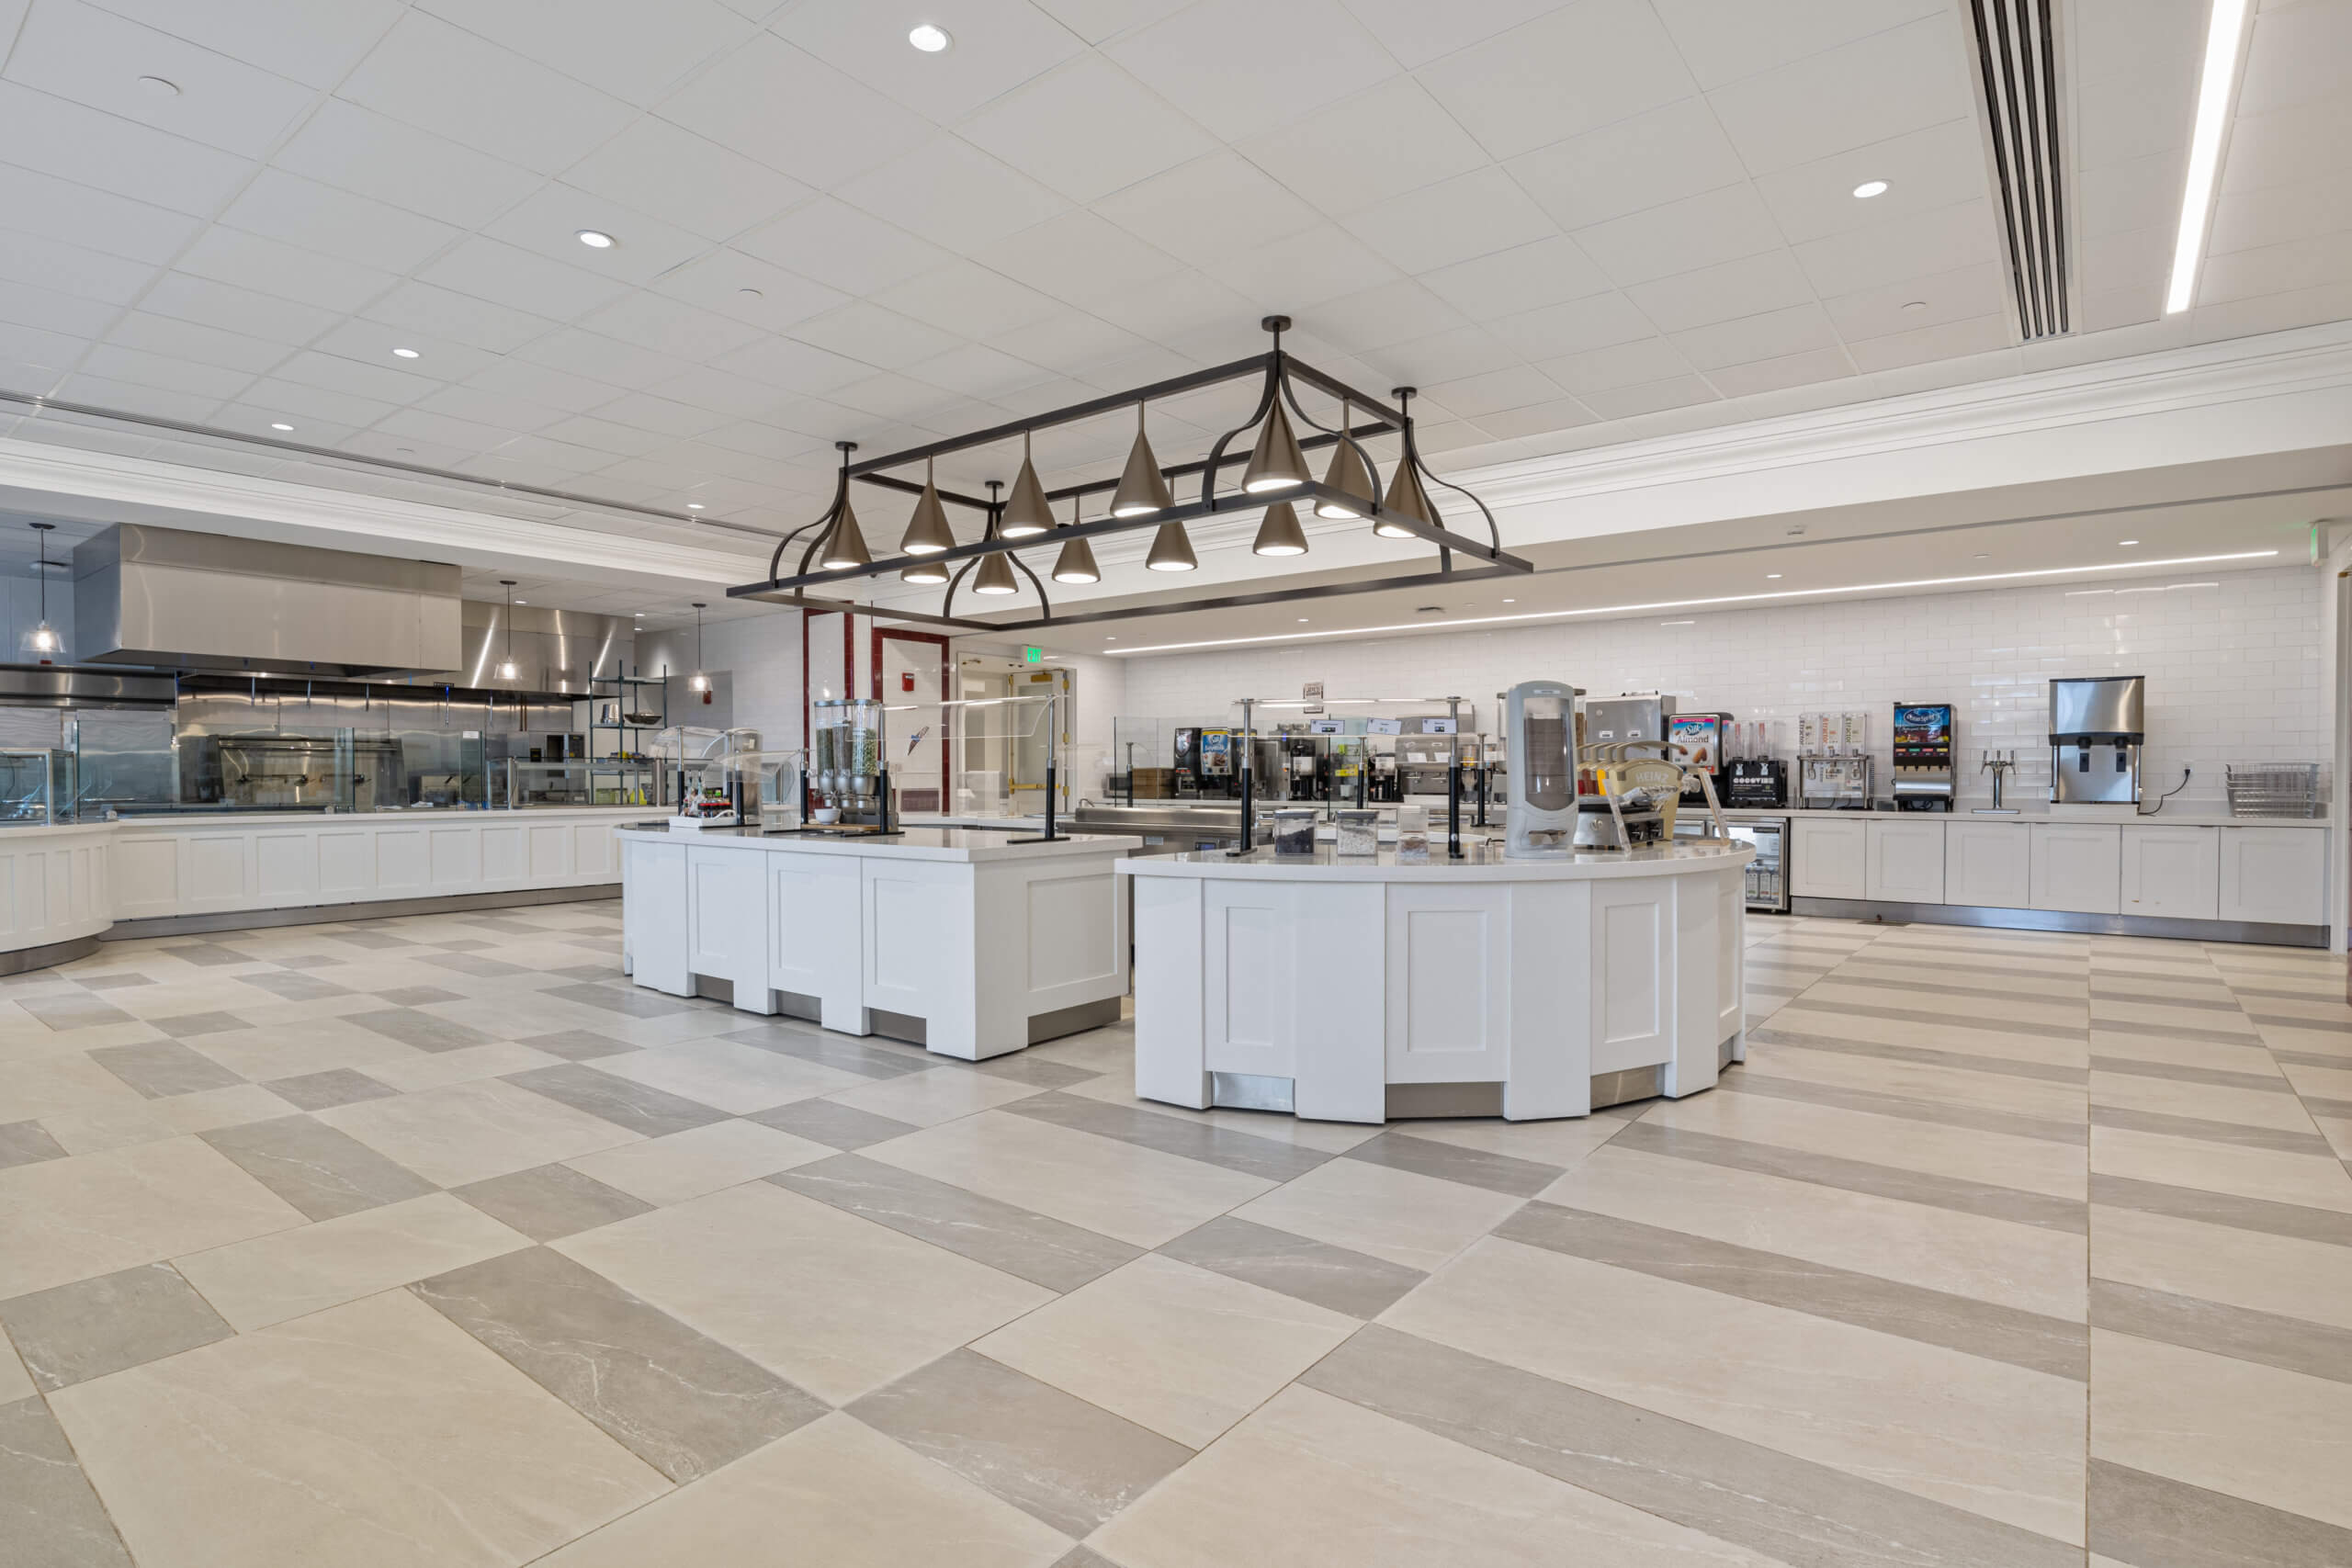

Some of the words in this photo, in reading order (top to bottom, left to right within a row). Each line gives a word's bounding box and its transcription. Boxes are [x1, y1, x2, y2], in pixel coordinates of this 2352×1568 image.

[1027, 648, 1041, 661] EXIT
[1684, 724, 1702, 735] Silk
[1677, 735, 1709, 743] Almond
[1635, 772, 1668, 784] HEINZ
